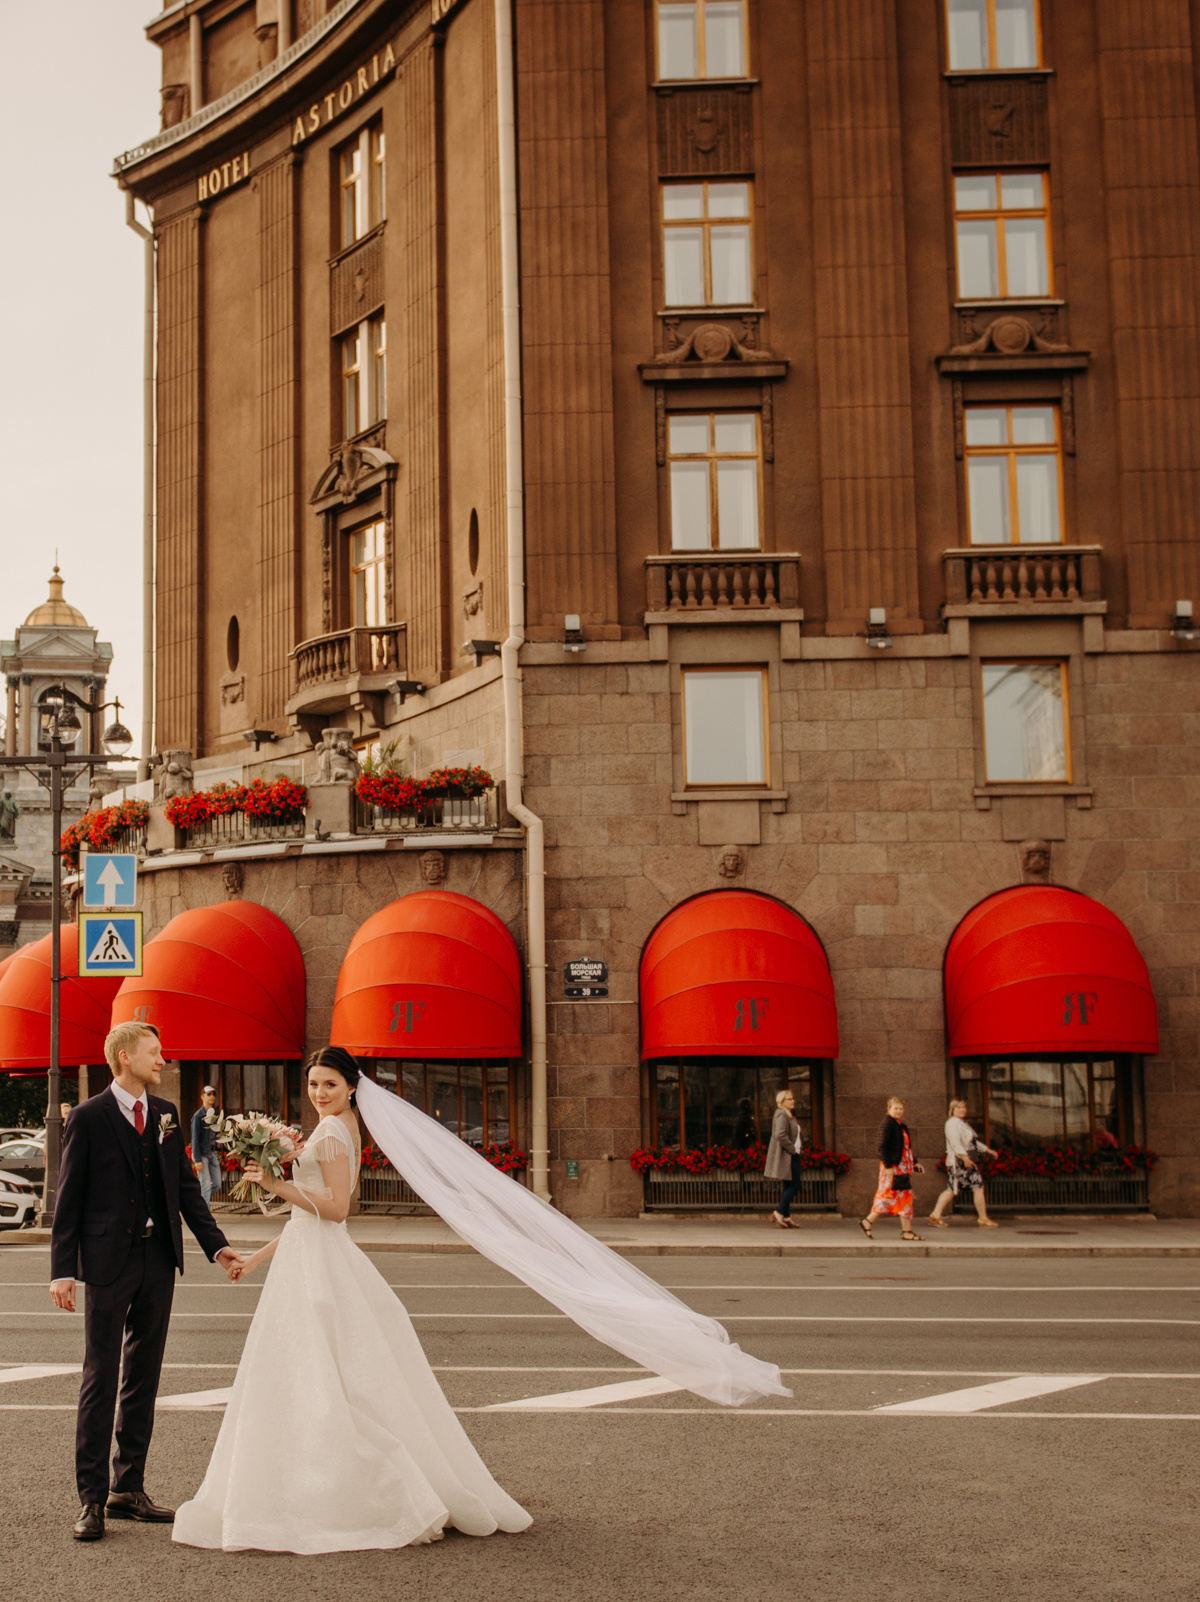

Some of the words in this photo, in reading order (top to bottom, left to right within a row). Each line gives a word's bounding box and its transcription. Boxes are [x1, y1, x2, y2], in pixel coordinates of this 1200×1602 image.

[198, 151, 253, 201] HOTEL
[292, 43, 396, 145] ASTORIA
[581, 988, 591, 996] 39
